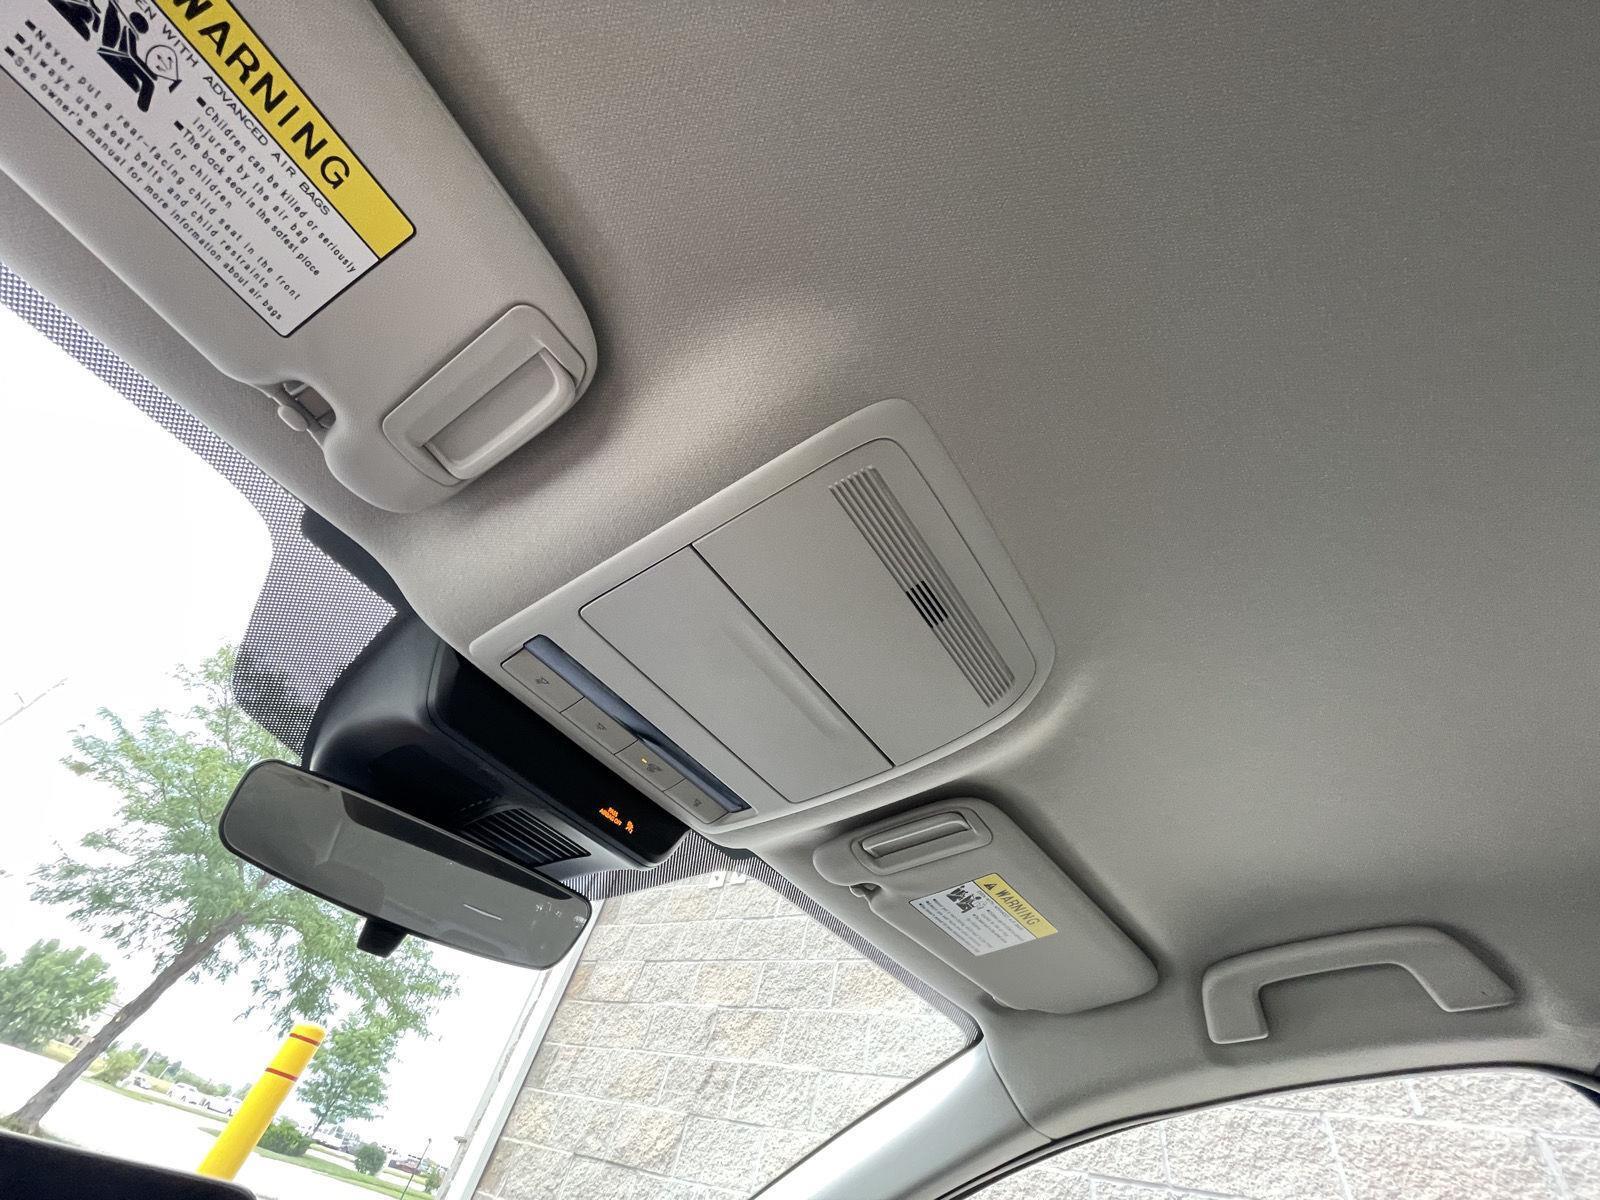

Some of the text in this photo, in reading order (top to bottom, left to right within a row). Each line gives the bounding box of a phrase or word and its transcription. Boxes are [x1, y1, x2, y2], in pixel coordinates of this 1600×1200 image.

[15, 56, 37, 80] See
[86, 128, 126, 166] manual
[127, 166, 143, 182] for
[144, 185, 168, 208] more
[170, 209, 221, 261] information
[223, 262, 249, 286] about
[248, 287, 262, 299] air
[262, 300, 281, 320] bags
[24, 44, 269, 288] Always use seat belts and child restraints
[36, 30, 300, 300] Never put a rear-facing child seat in the front
[162, 24, 199, 68] WITH
[203, 75, 269, 146] ADVANCED
[271, 152, 296, 178] AIR
[299, 182, 330, 216] BAGS
[169, 142, 232, 208] for children
[183, 129, 320, 276] The back seat is the safest place
[193, 117, 308, 244] injured by the air bag
[205, 106, 356, 273] Children can be killed or seriously
[995, 889, 1040, 925] WARNING
